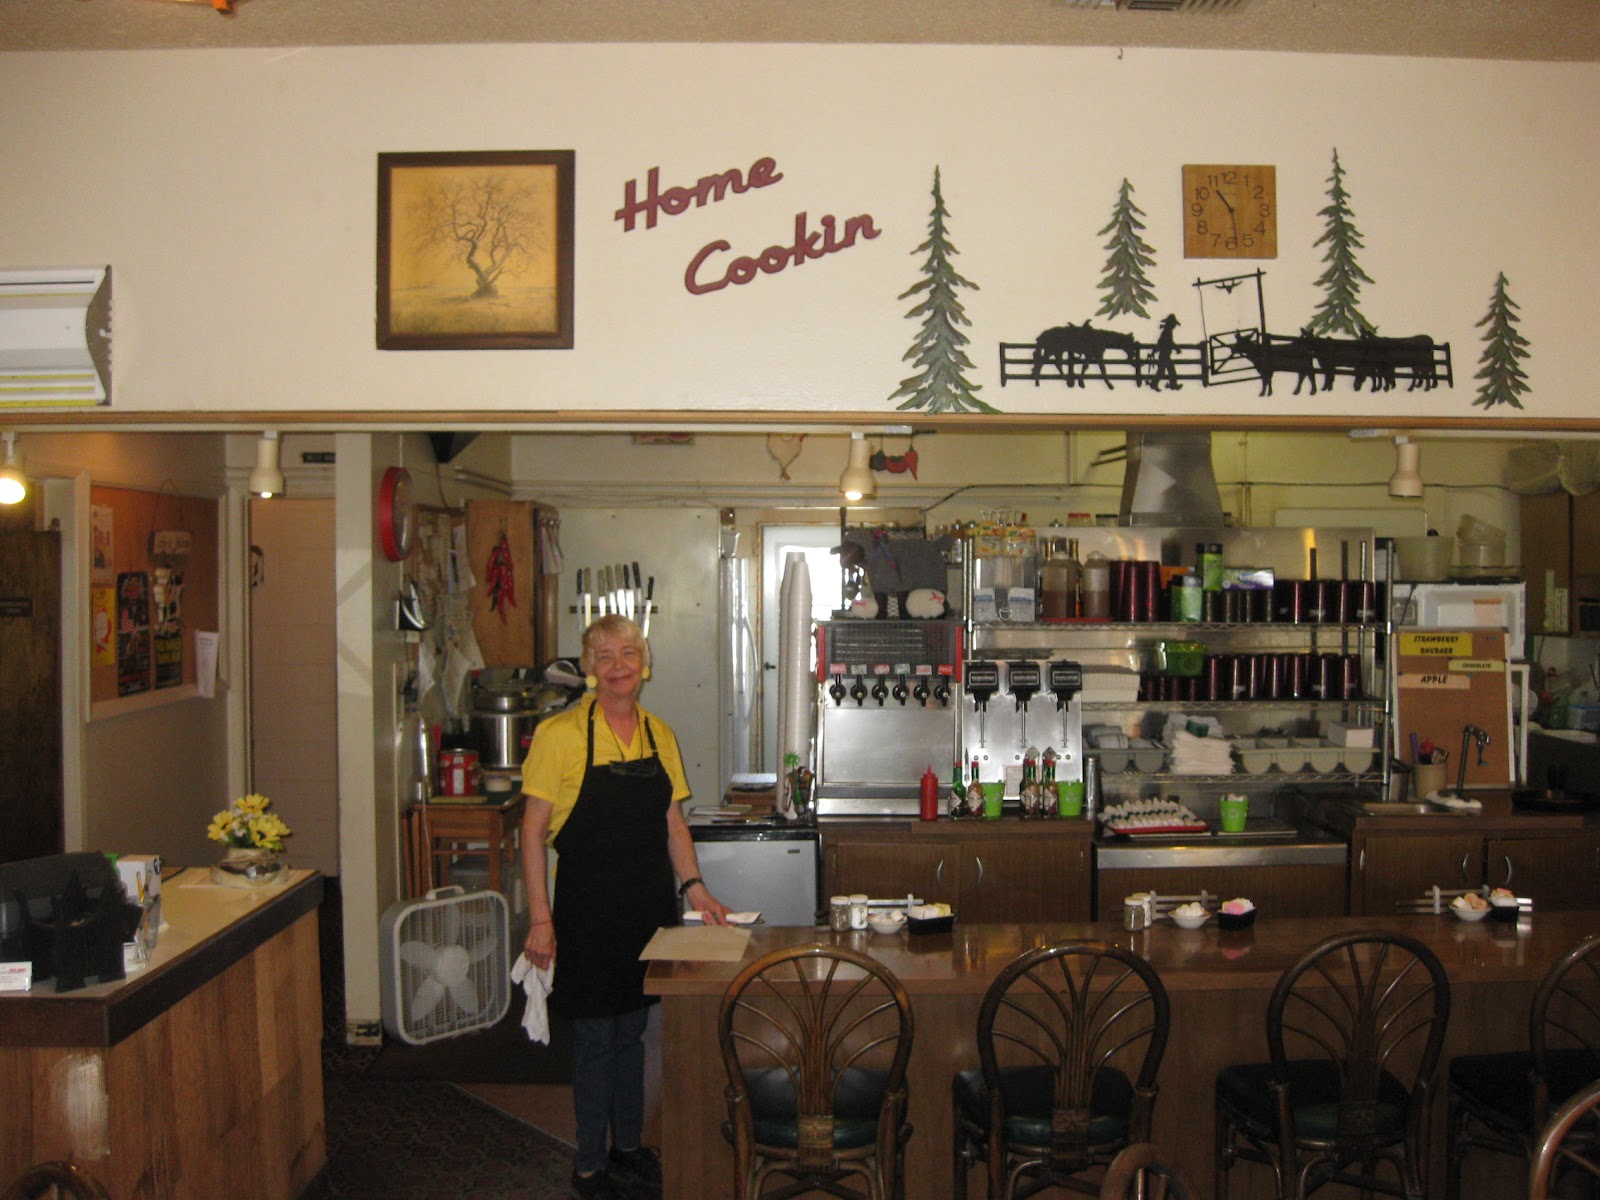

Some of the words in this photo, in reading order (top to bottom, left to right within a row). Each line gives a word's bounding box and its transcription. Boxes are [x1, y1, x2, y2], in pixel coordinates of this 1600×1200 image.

[1208, 175, 1219, 187] 11
[1222, 171, 1237, 184] 12
[1244, 175, 1249, 187] 1
[614, 156, 784, 232] Home
[1195, 186, 1209, 201] 10
[1253, 185, 1264, 200] 2
[1191, 203, 1203, 217] 9
[1259, 203, 1270, 218] 3
[1197, 220, 1208, 234] 8
[1253, 221, 1265, 236] 4
[1210, 233, 1221, 247] 7
[1226, 236, 1238, 251] 6
[1242, 234, 1254, 247] 5
[684, 211, 882, 295] Cookin
[1420, 675, 1448, 684] APPLE
